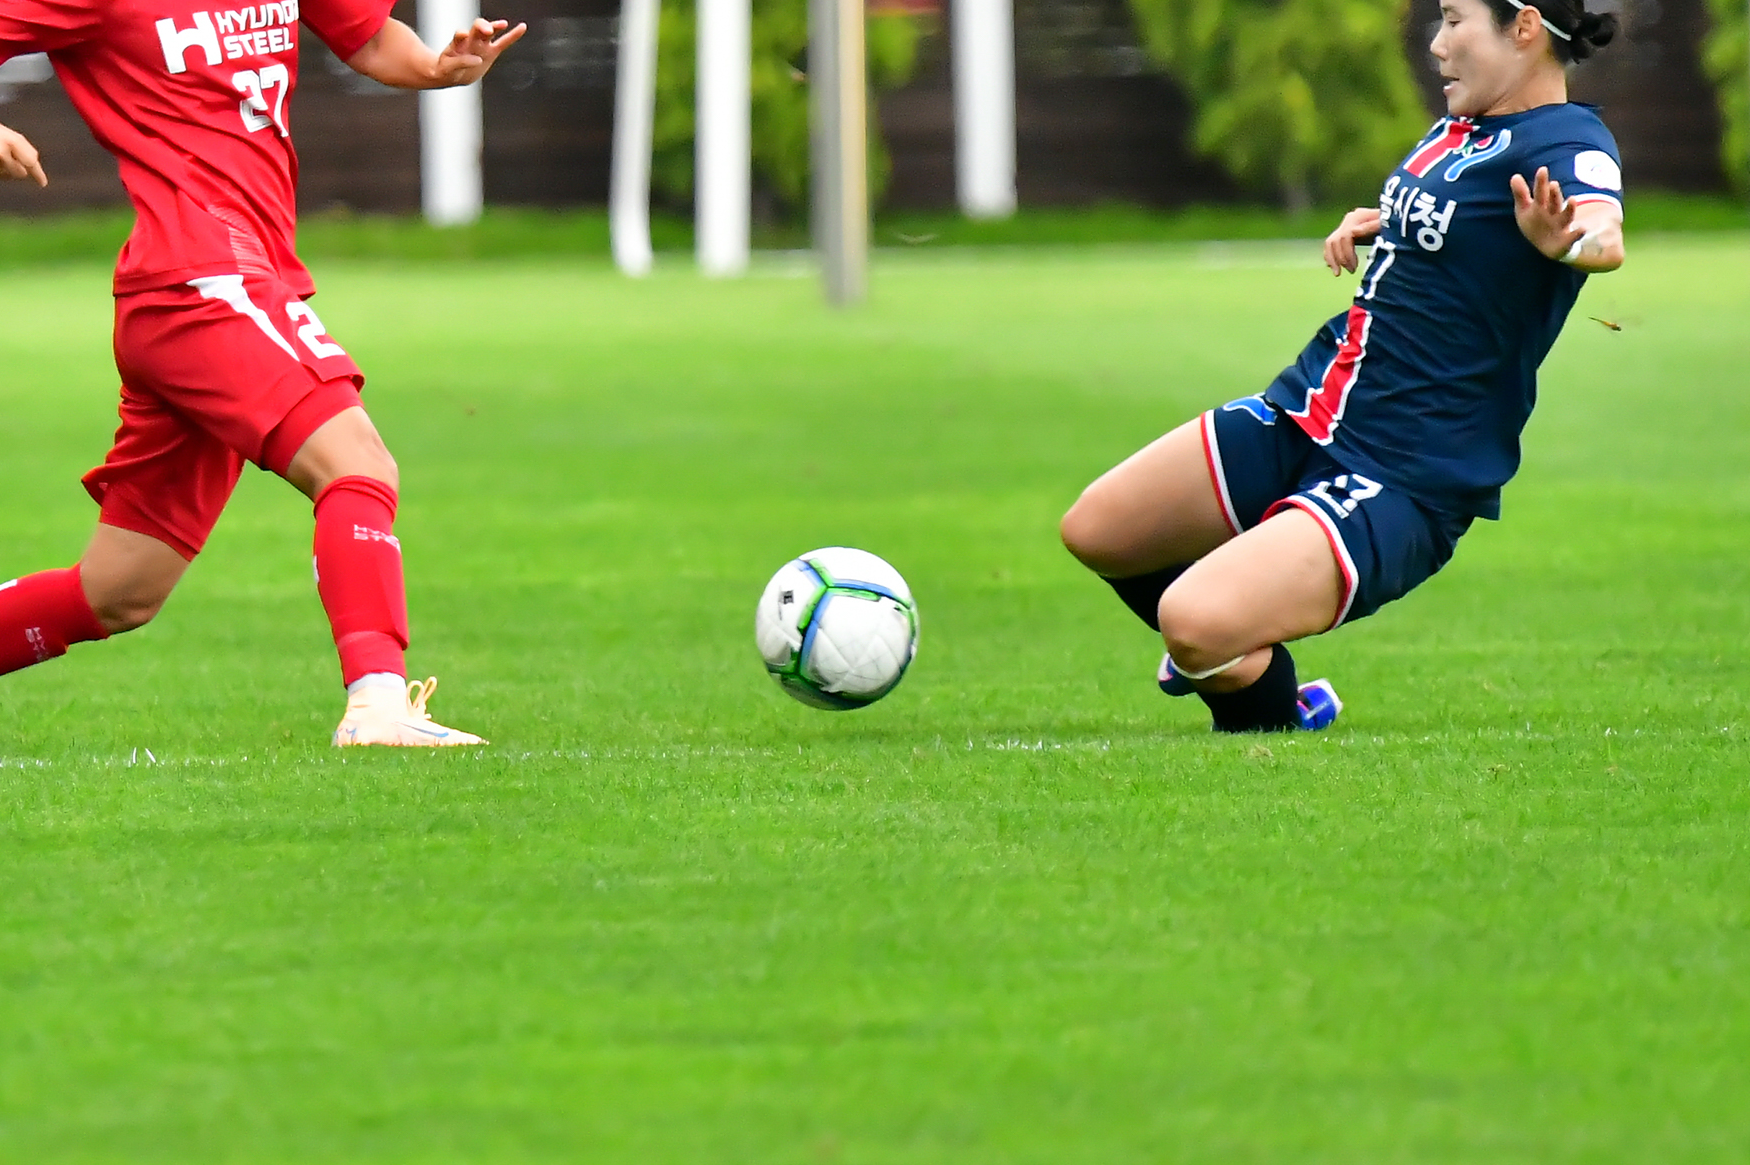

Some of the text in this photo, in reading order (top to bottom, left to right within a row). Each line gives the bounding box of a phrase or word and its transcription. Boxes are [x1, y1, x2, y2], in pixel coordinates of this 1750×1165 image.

[155, 11, 223, 75] H
[224, 28, 294, 60] STEEL
[232, 64, 289, 138] 27
[1379, 176, 1457, 252] 울시청
[285, 301, 346, 359] 2
